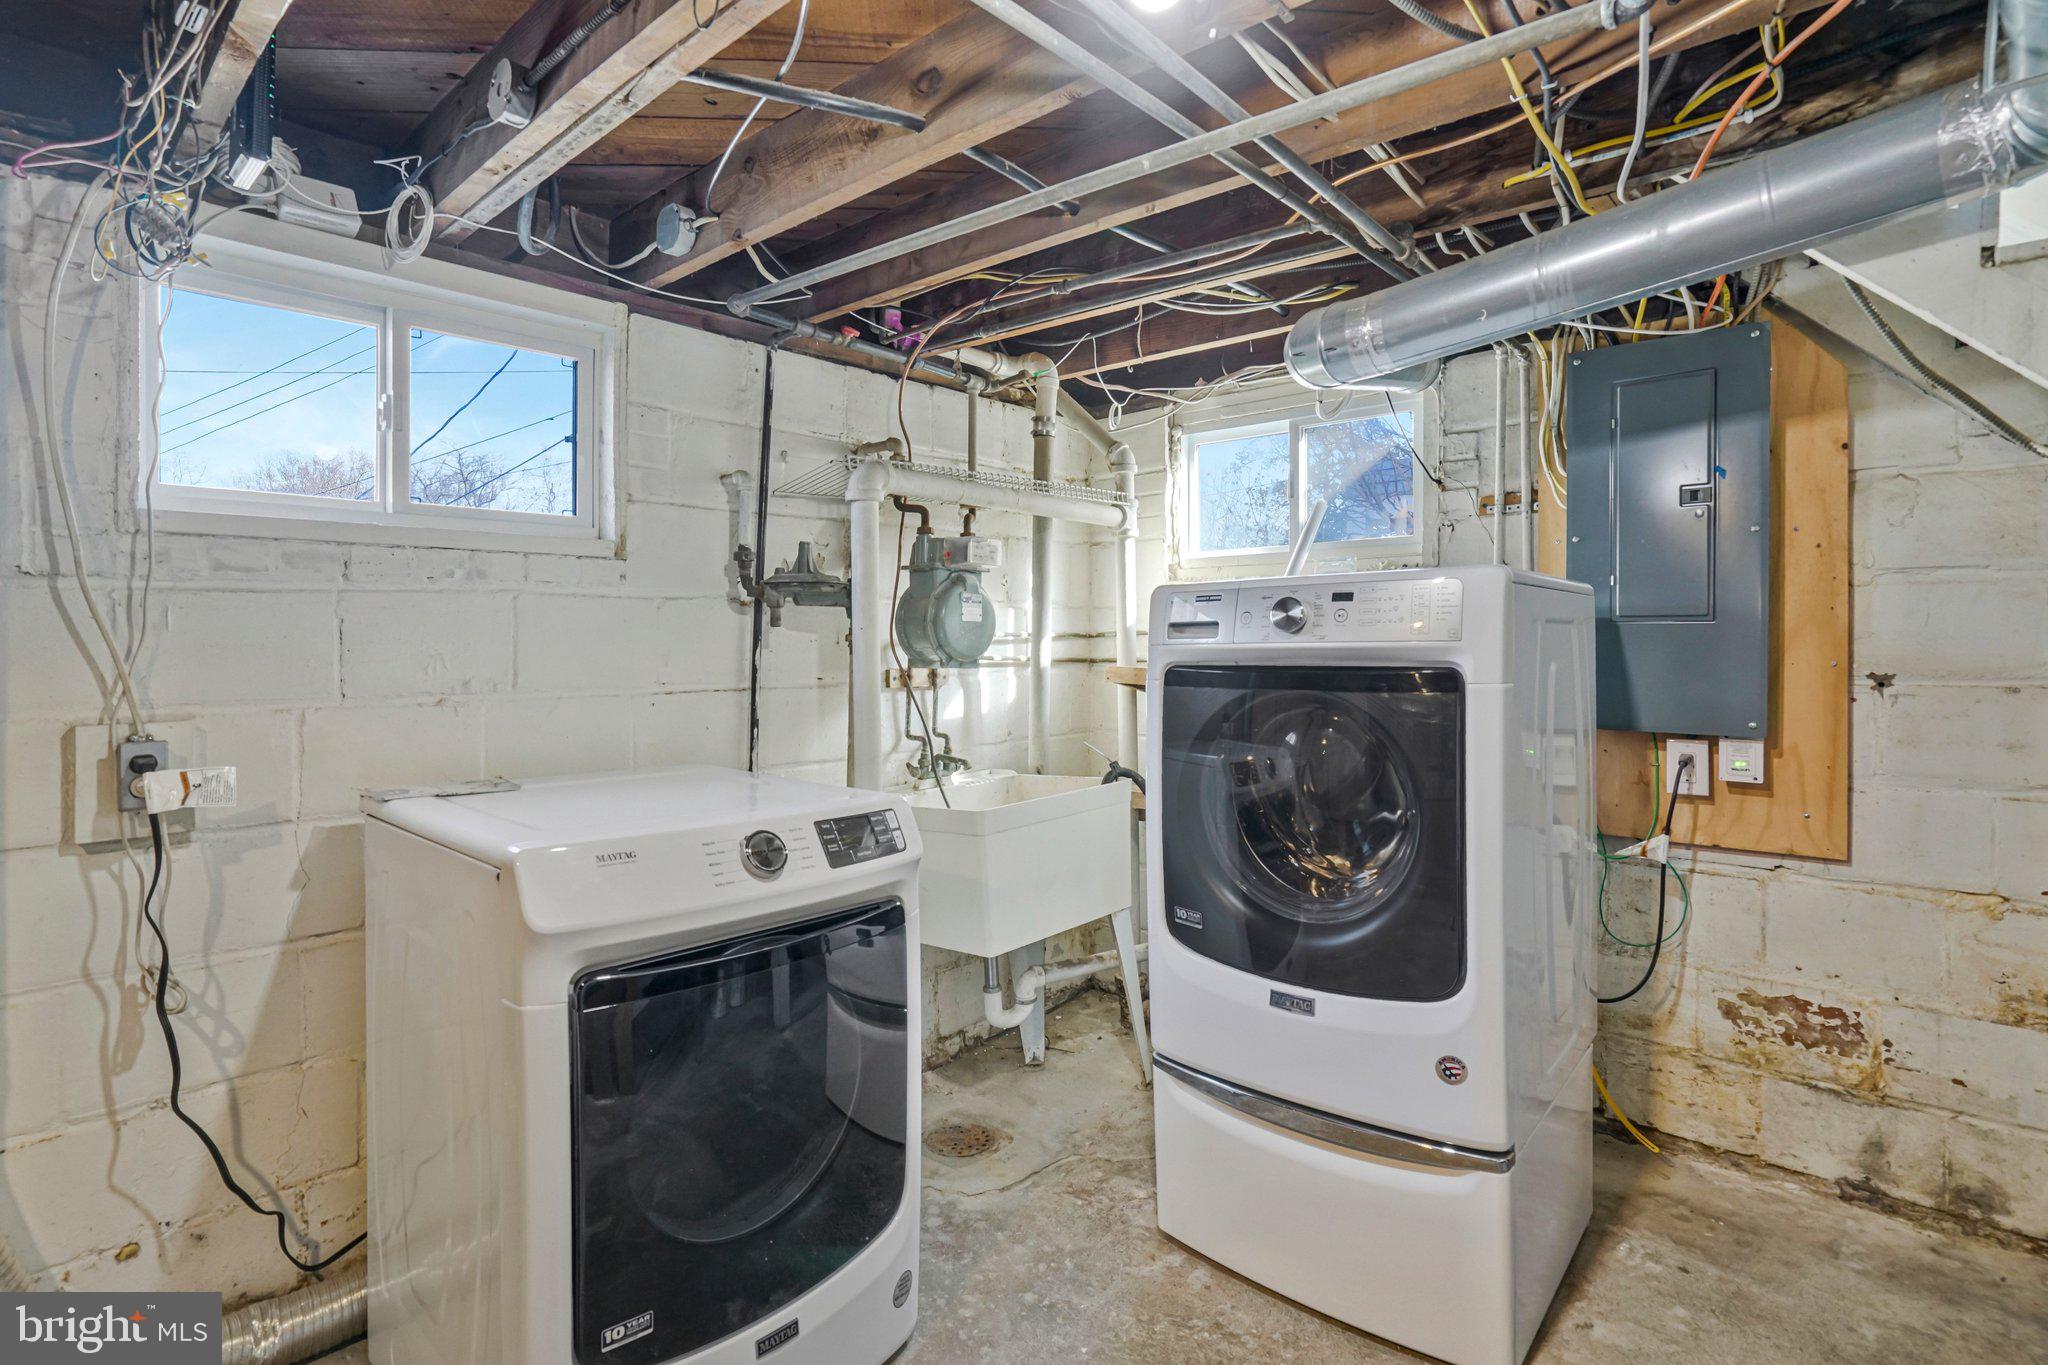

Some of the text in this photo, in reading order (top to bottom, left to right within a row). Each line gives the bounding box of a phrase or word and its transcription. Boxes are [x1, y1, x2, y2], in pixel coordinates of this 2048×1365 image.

[595, 850, 637, 863] MAYTAG
[1176, 908, 1187, 919] 10
[604, 1325, 625, 1344] 10
[627, 1314, 651, 1328] YEAR
[759, 1323, 798, 1355] MAYTAG
